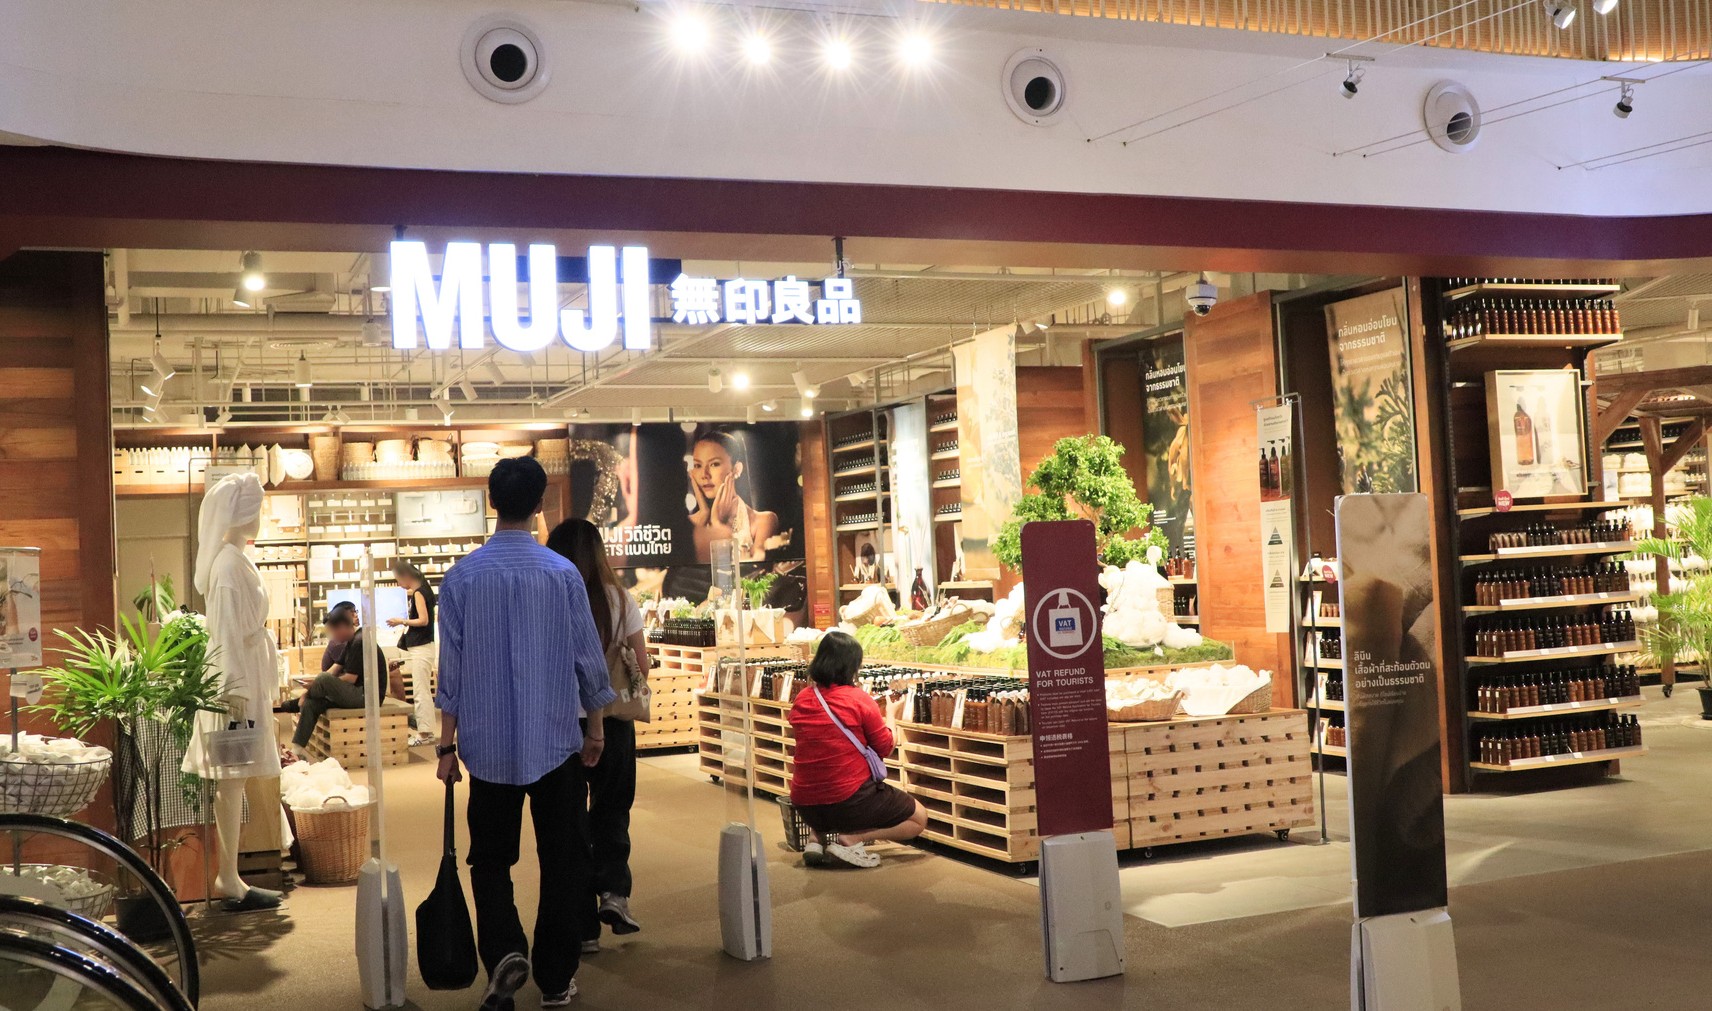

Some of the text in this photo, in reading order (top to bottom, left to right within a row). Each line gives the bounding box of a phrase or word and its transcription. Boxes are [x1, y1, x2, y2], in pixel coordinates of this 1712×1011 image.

[389, 240, 861, 351] MUJI 無印良品
[1339, 331, 1386, 352] จากธรรมชาติ
[599, 524, 671, 543] UJI วิถีชีวิต
[624, 541, 672, 556] แบบไทย
[1058, 619, 1072, 627] VAT
[1035, 667, 1086, 678] VAT REFUND
[1036, 676, 1094, 688] FOR TOURISTS
